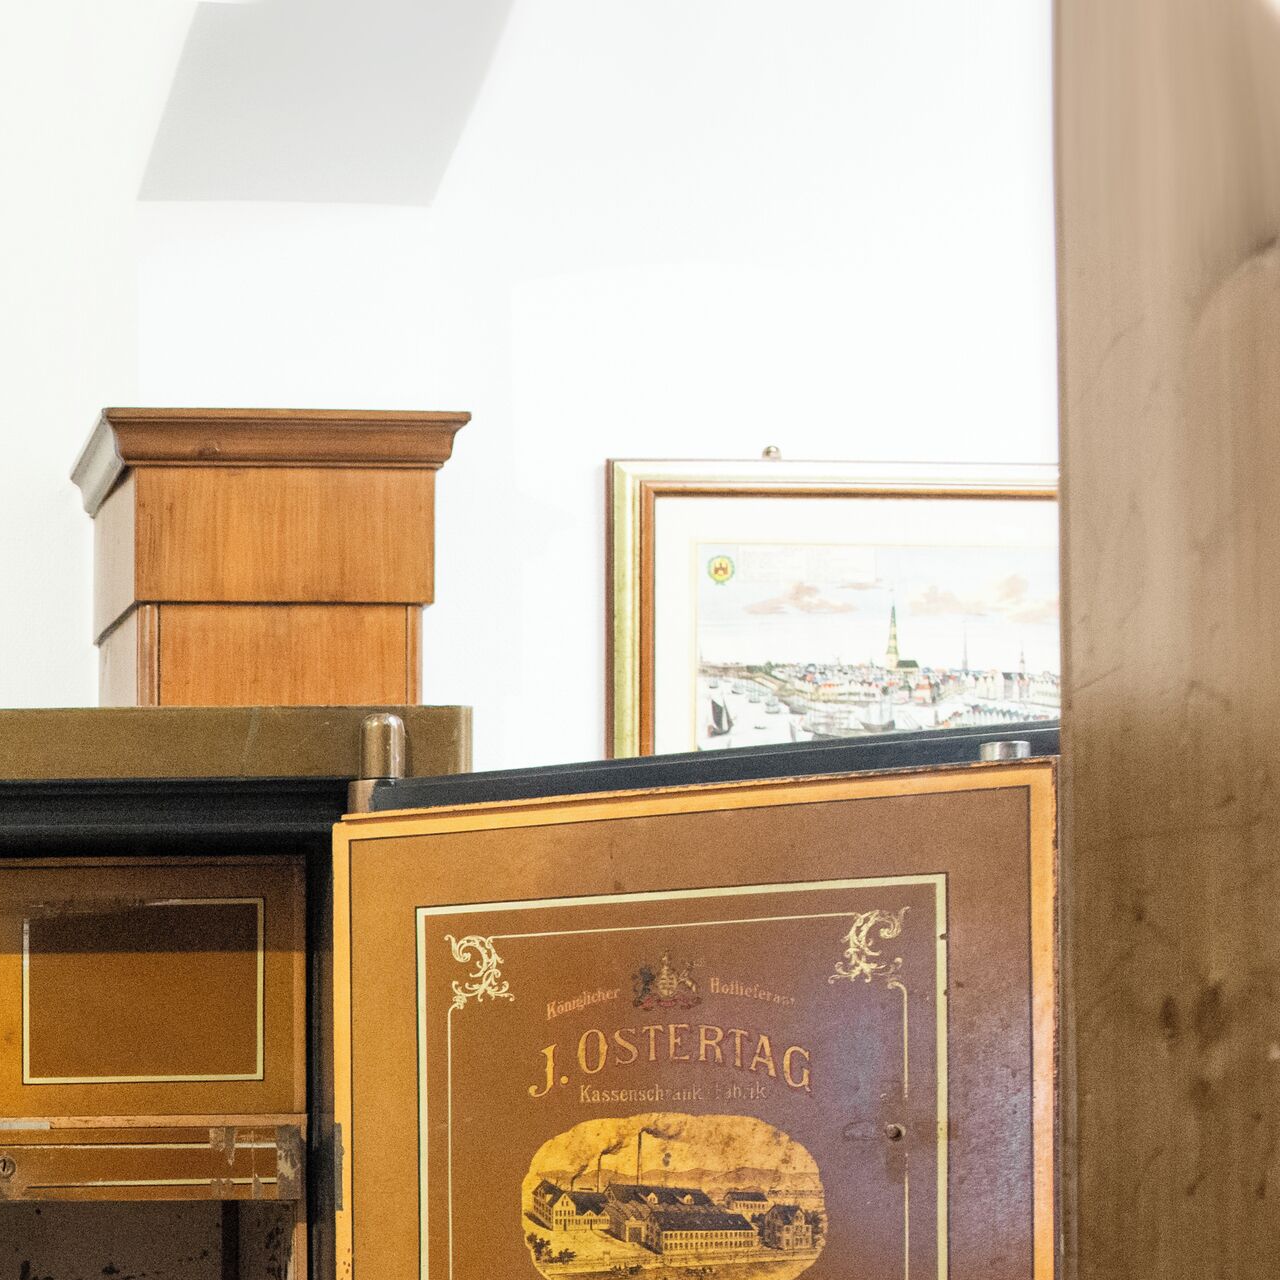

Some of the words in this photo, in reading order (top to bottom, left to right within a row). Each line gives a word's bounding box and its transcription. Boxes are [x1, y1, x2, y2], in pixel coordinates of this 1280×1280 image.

[546, 988, 621, 1020] Königlicher
[528, 1043, 569, 1098] J.
[576, 1022, 812, 1092] OSTERTAG
[580, 1083, 703, 1103] Kassenschank
